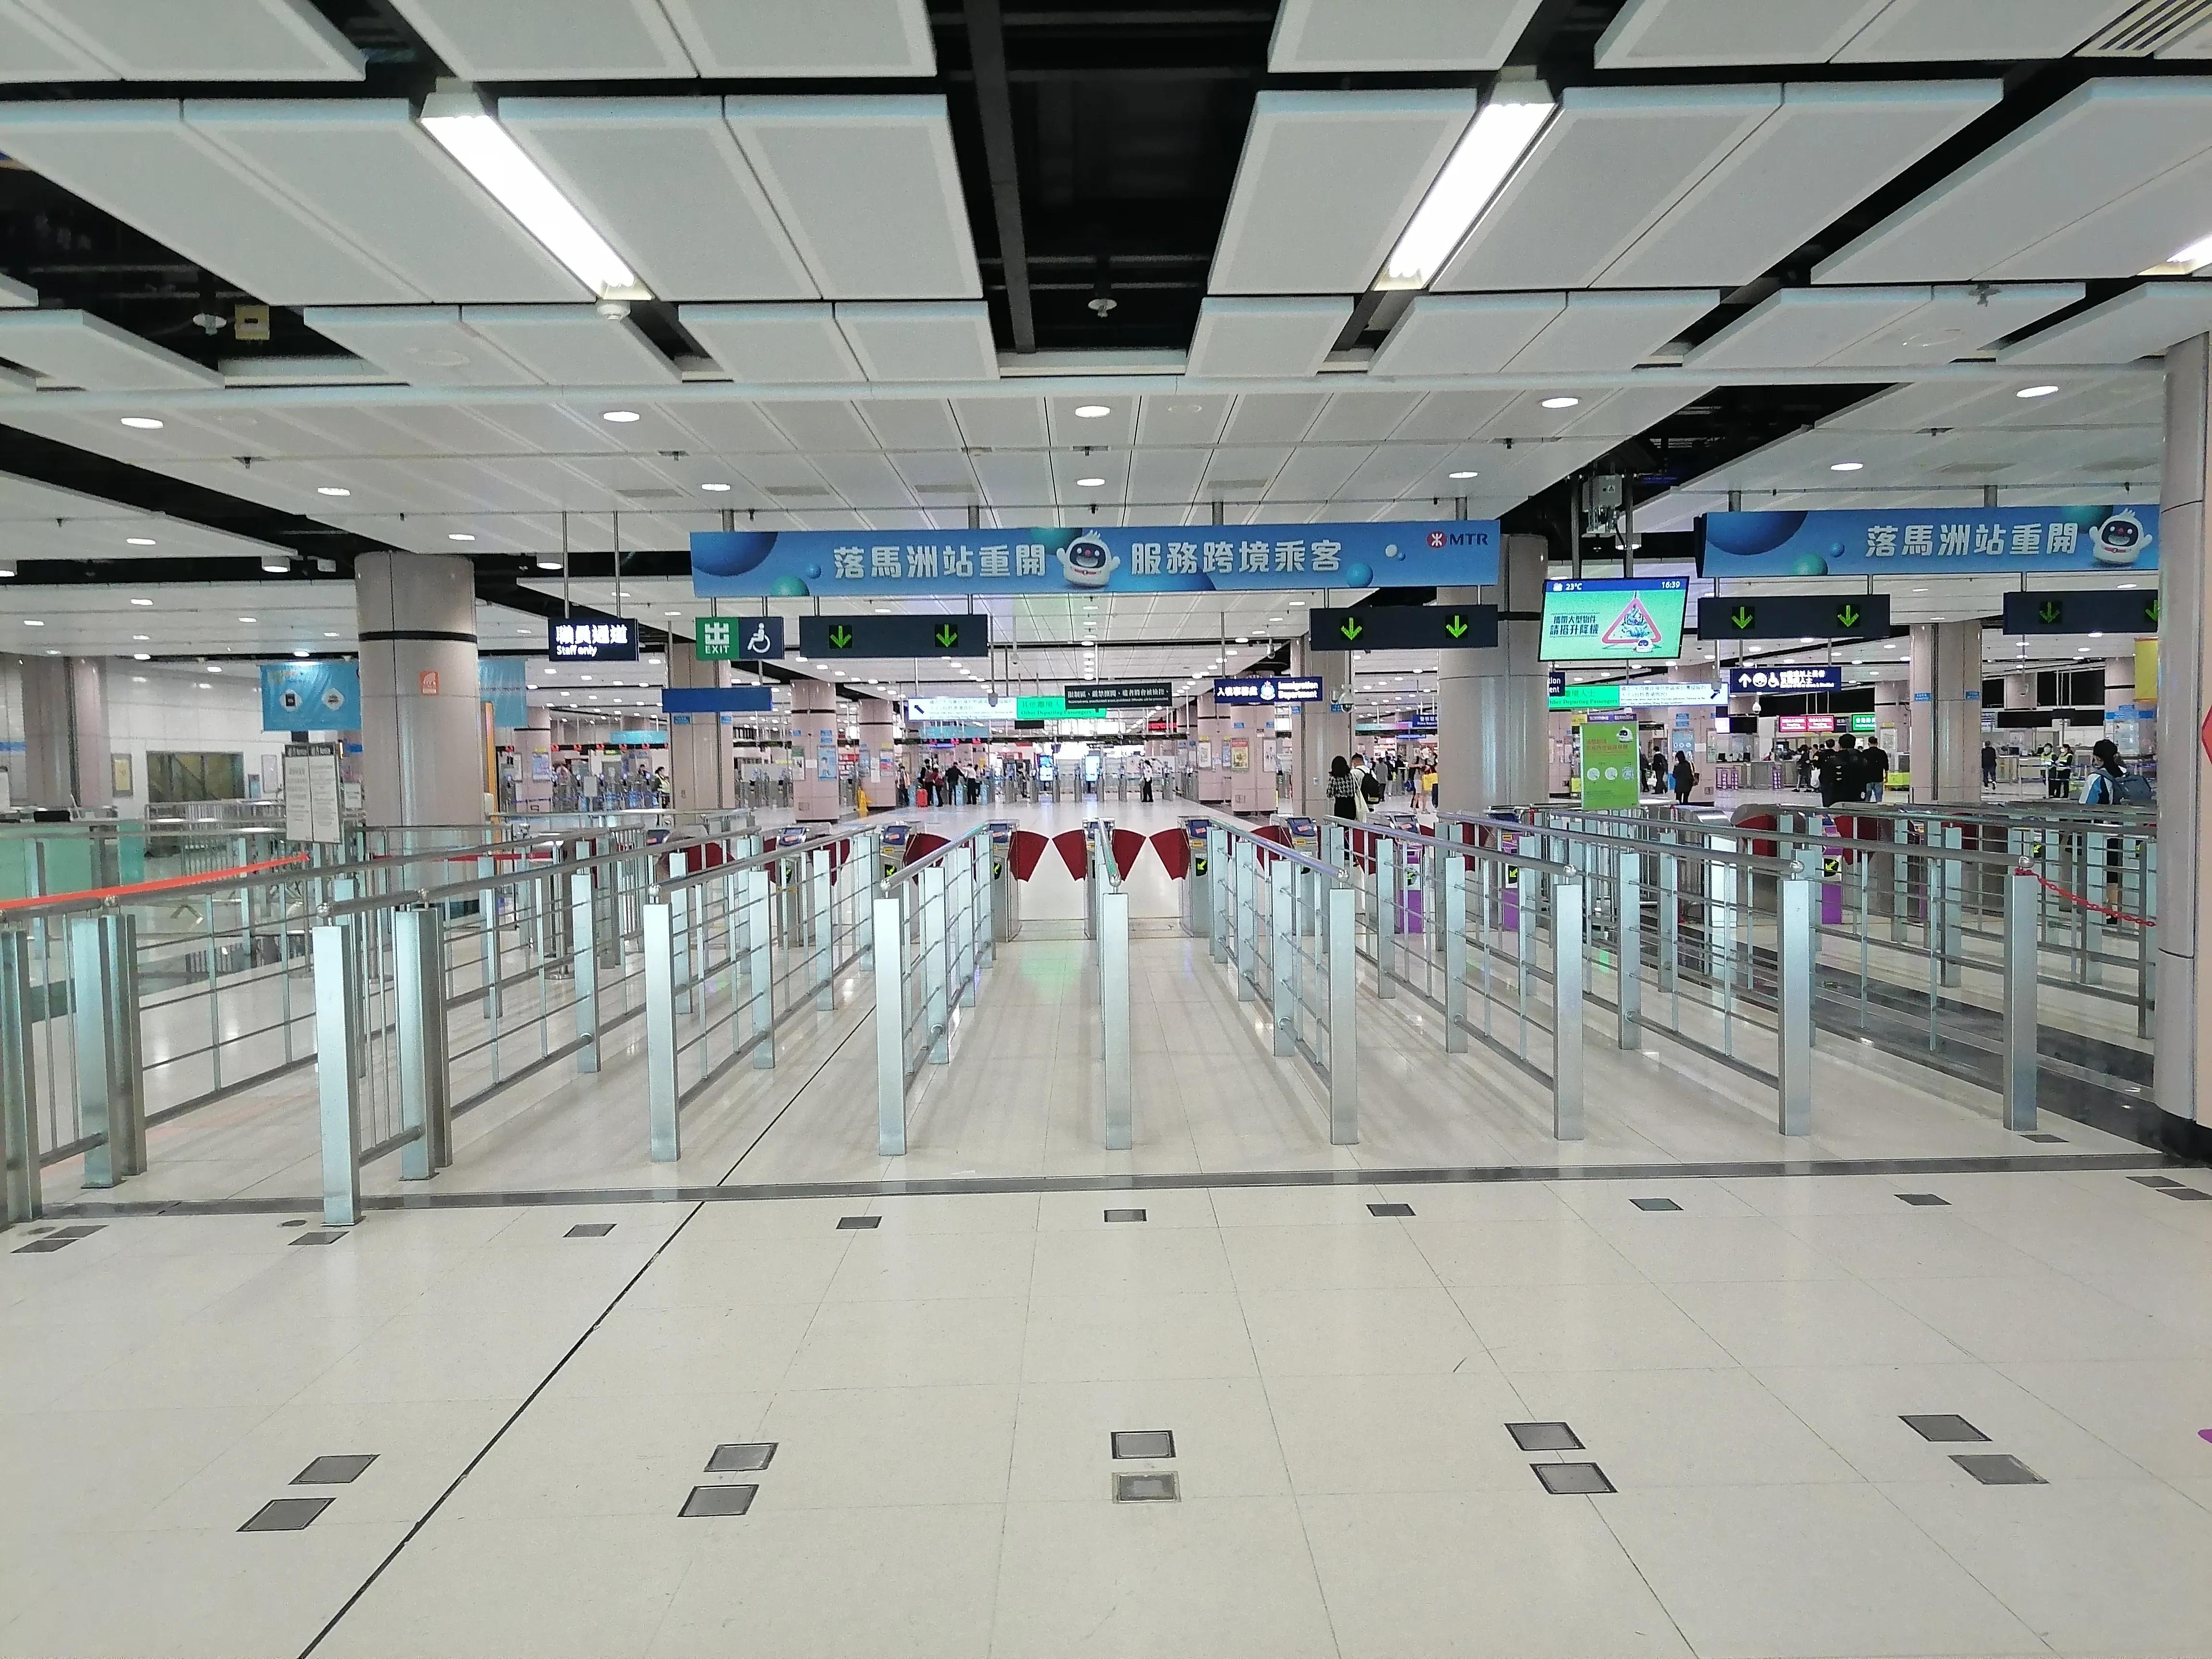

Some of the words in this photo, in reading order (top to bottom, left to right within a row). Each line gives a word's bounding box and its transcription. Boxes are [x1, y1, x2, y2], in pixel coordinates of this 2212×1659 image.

[1450, 533, 1488, 545] MTR
[1865, 523, 2078, 557] 落馬洲站重開
[834, 543, 1046, 579] 落馬洲站重開
[1130, 539, 1343, 576] 服務跨境乘客
[704, 622, 729, 644] 出
[556, 645, 577, 655] Staff
[577, 645, 598, 657] only
[705, 645, 730, 654] EXIT
